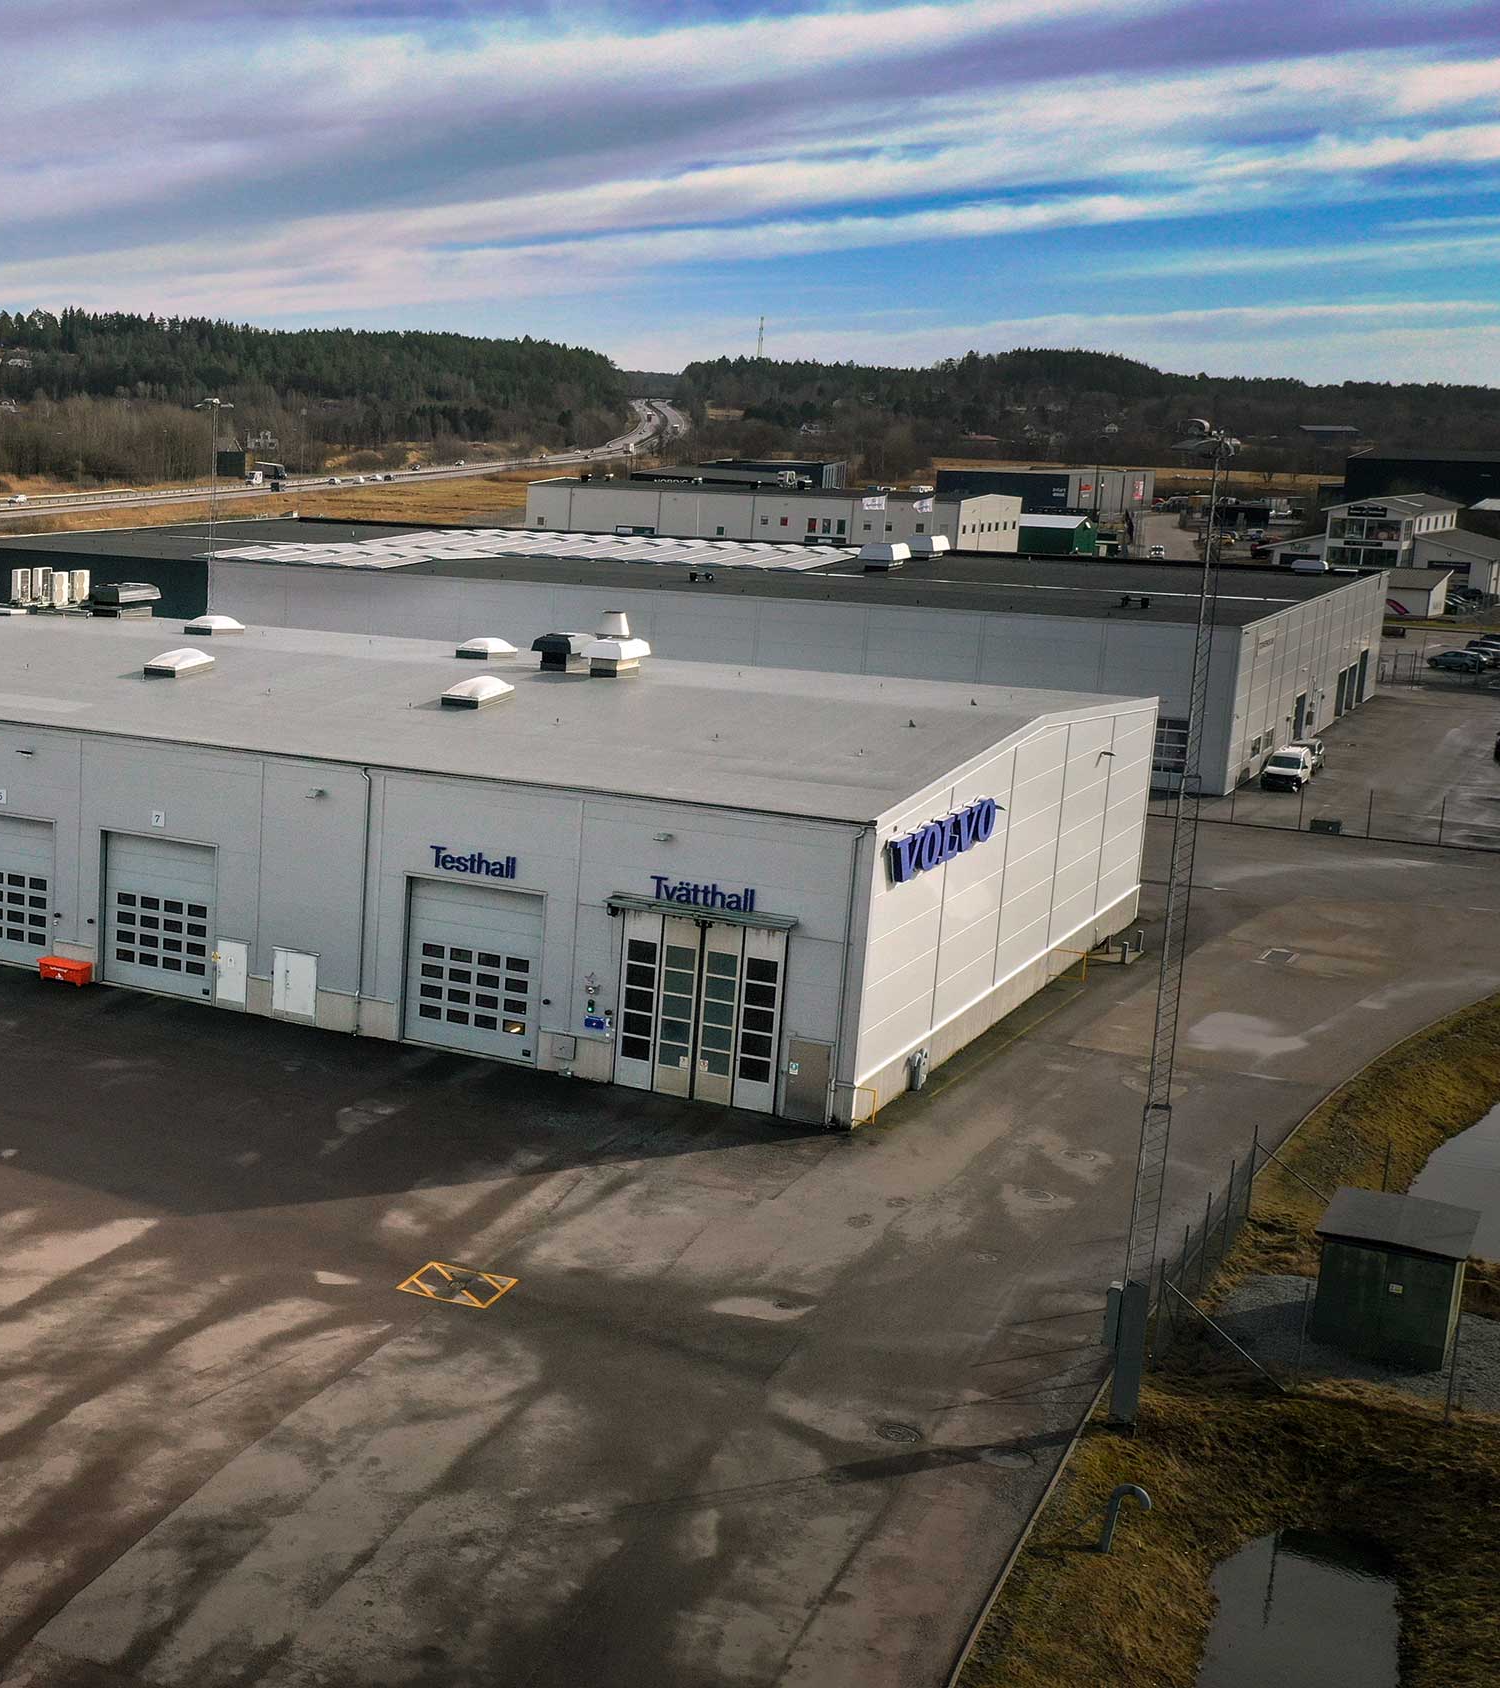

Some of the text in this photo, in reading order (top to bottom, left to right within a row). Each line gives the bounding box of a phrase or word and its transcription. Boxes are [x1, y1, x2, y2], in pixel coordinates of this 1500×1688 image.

[155, 814, 161, 823] 7
[889, 798, 996, 883] VOLVO
[430, 845, 517, 879] Testhall
[650, 875, 755, 912] Tvätthall
